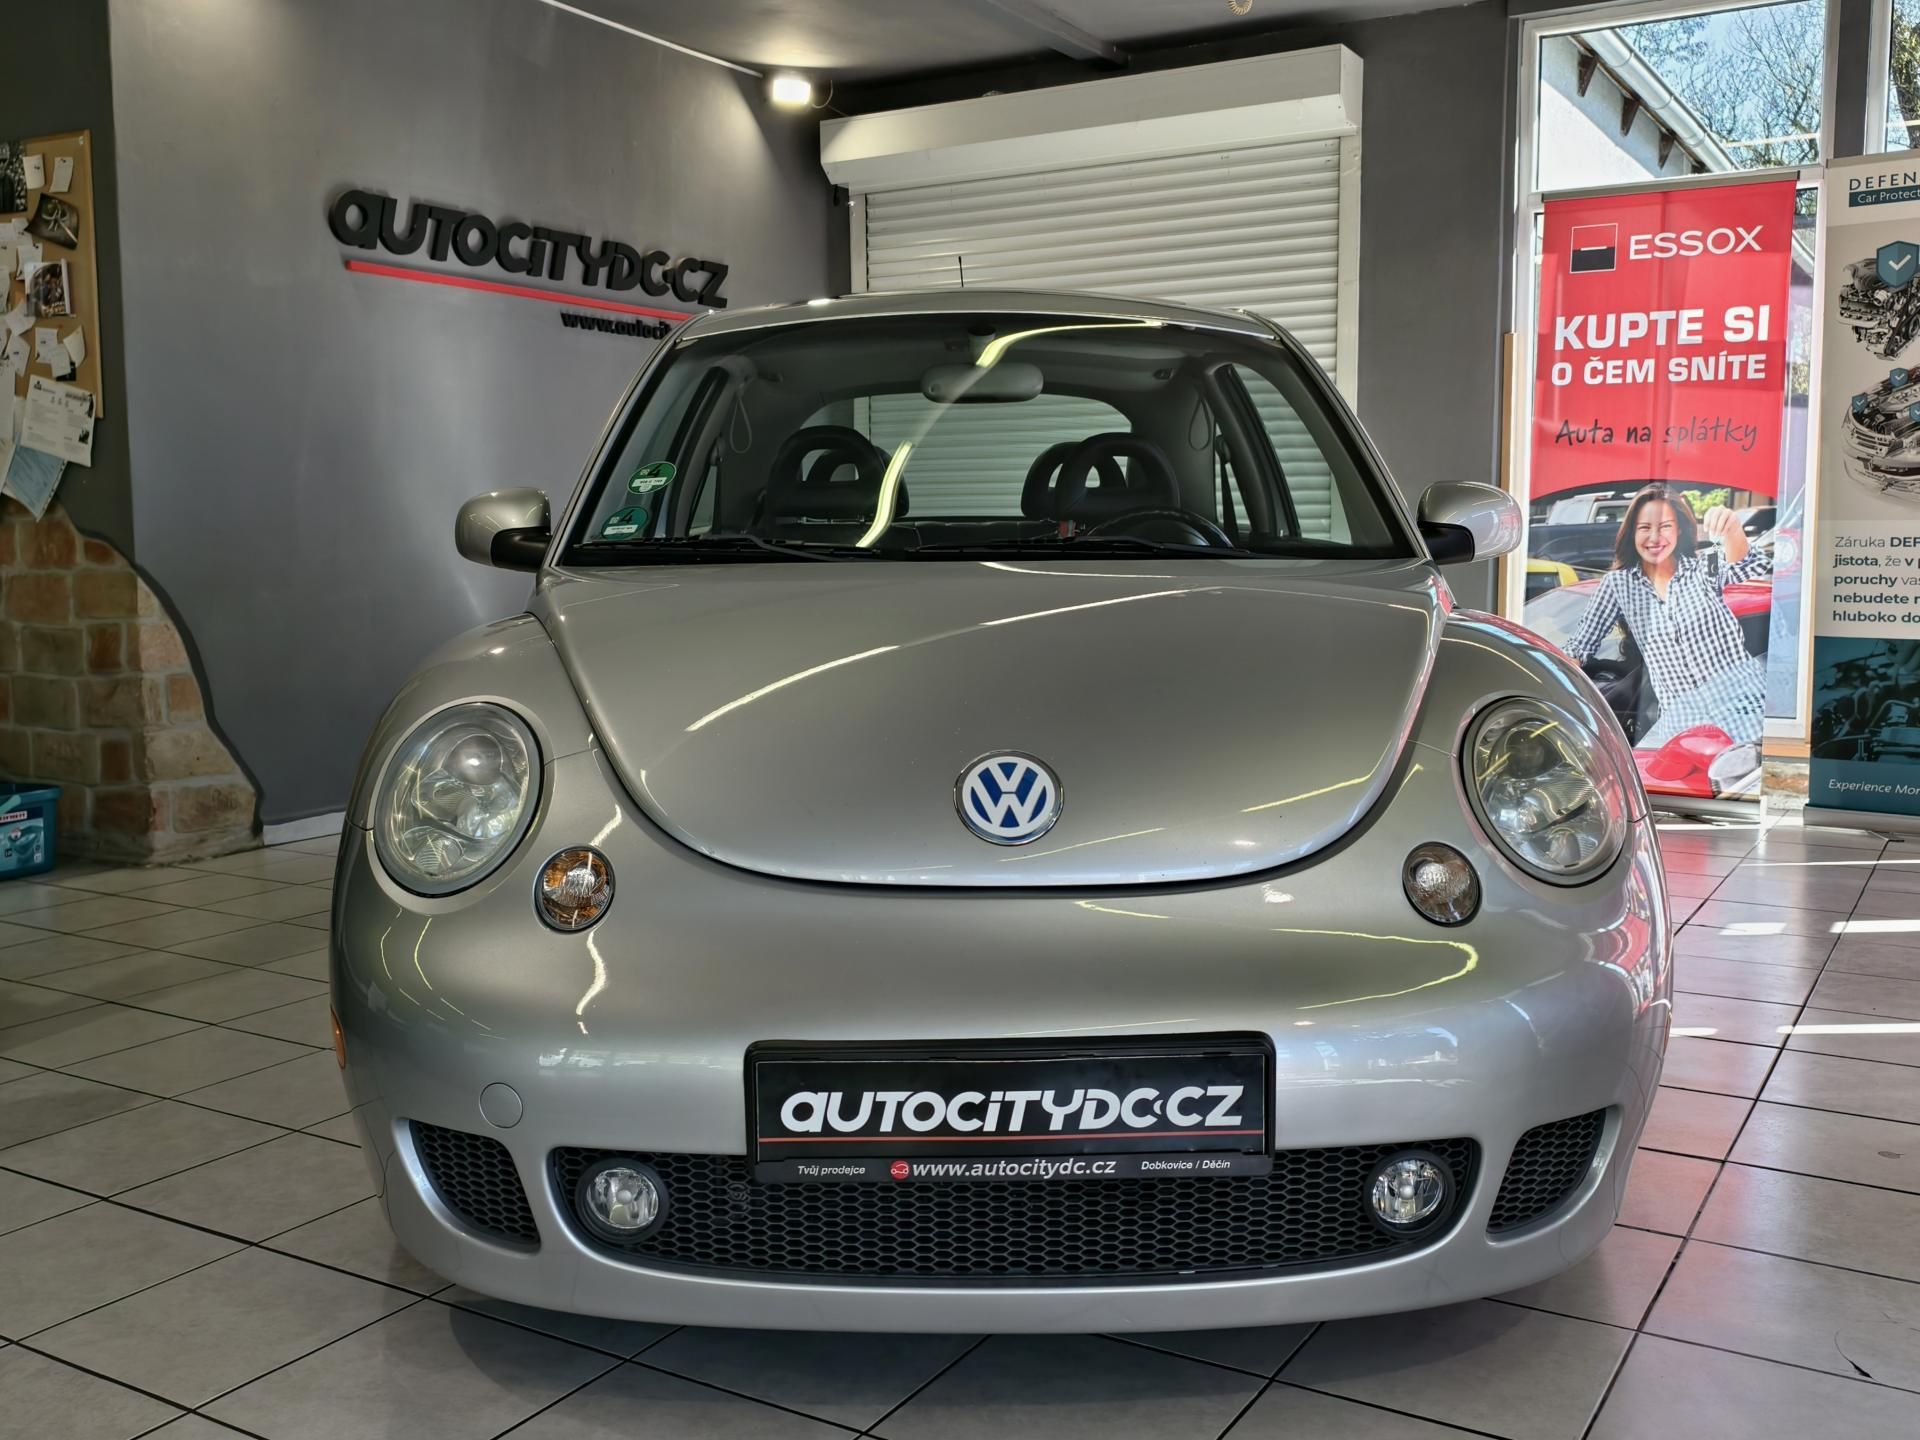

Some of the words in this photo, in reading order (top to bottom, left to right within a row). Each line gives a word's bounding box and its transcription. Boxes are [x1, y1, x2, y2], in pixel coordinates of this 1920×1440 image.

[1857, 193, 1877, 203] Car
[1629, 224, 1764, 260] ESSOX
[1554, 308, 1704, 351] KUPTE
[1723, 304, 1770, 343] SI
[1551, 361, 1573, 387] O
[1583, 355, 1656, 385] ČEM
[1667, 350, 1767, 383] SNÍTE
[1555, 418, 1614, 446] Auta
[1626, 426, 1652, 444] na
[1663, 416, 1758, 452] splátky
[647, 462, 663, 477] 4
[1834, 535, 1886, 548] Záruka
[1832, 554, 1881, 569] jistota,
[1884, 555, 1902, 567] že
[1904, 557, 1915, 567] v
[1833, 574, 1898, 588] poruchy
[1833, 592, 1910, 604] nebudete
[1832, 610, 1897, 623] hluboko
[1828, 778, 1892, 793] Experience
[797, 1164, 819, 1176] Tvůj
[821, 1164, 866, 1177] prodejce
[912, 1157, 1117, 1180] www.autocitydc.cz
[1140, 1159, 1193, 1171] Dobkovice
[1202, 1159, 1231, 1170] Děčín
